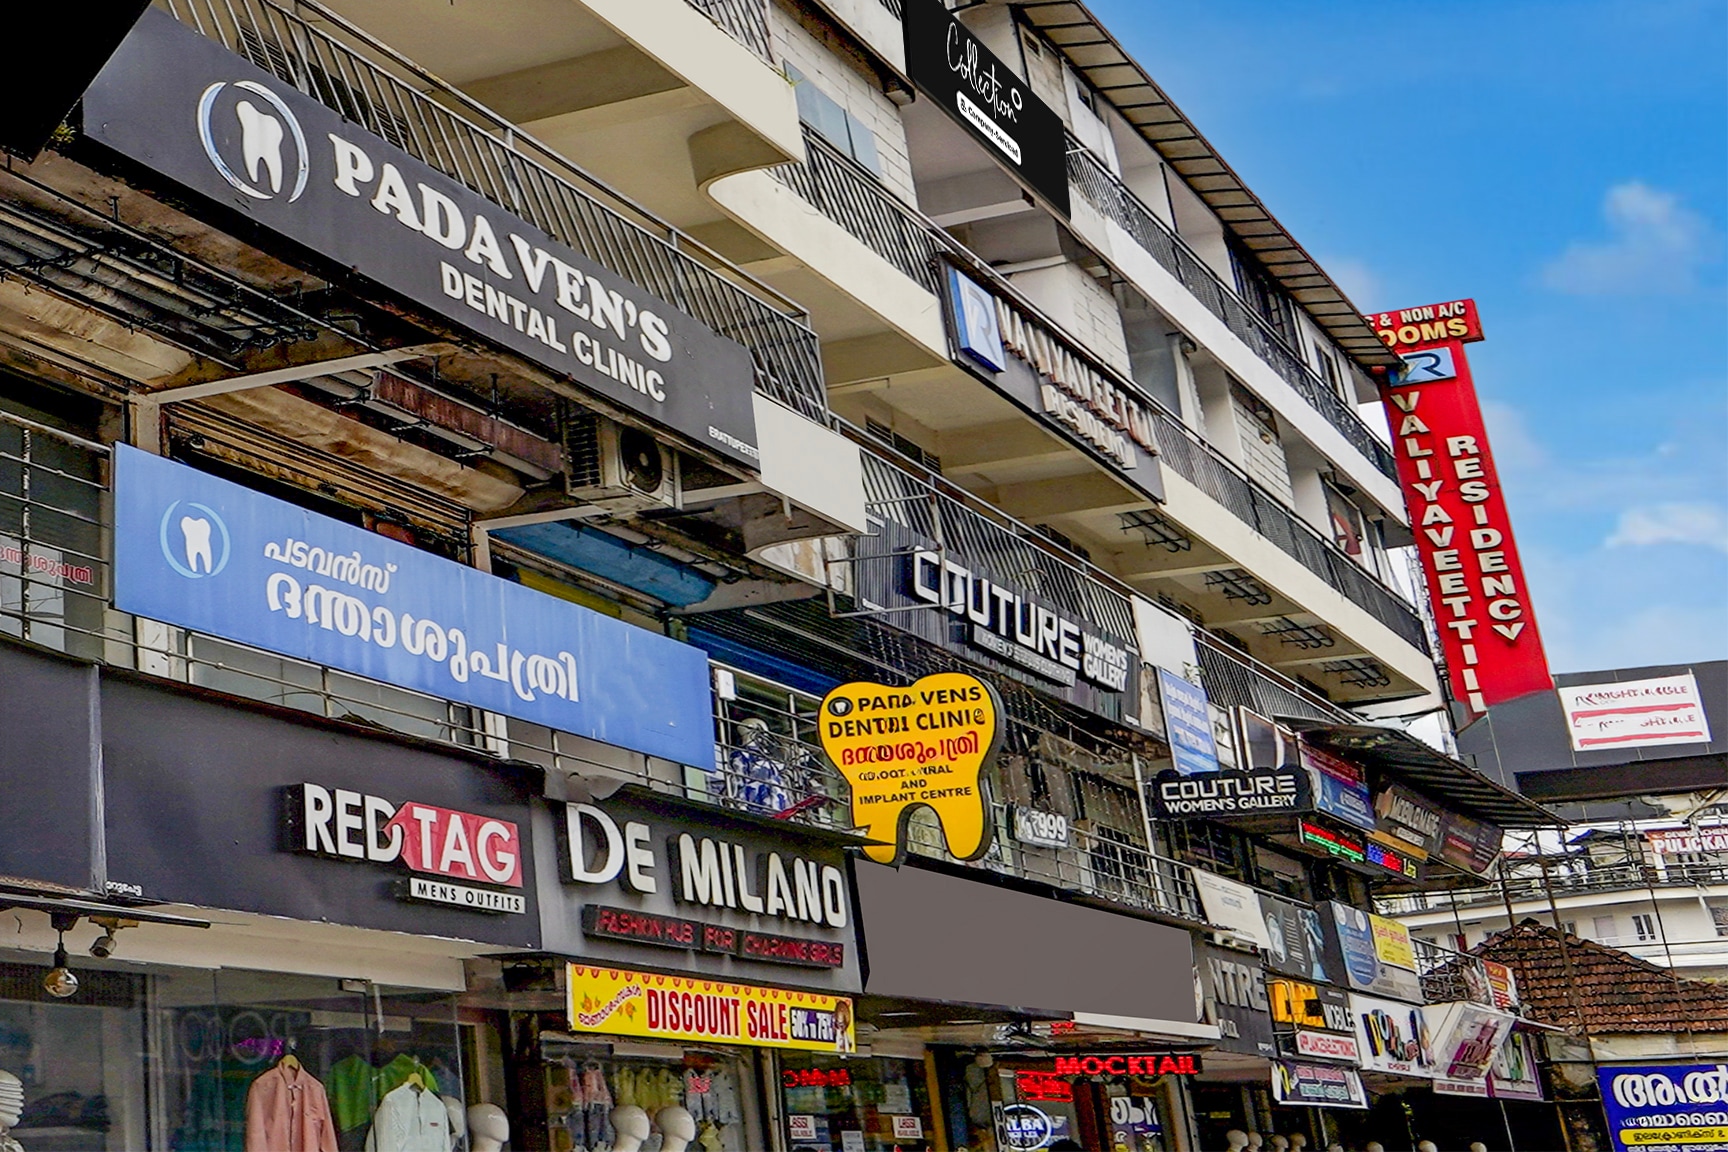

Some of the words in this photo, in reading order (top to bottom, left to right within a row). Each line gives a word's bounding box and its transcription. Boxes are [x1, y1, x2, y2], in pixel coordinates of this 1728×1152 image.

[1400, 307, 1435, 323] NON
[1438, 301, 1466, 318] A/C
[440, 261, 567, 355] DENTAL
[573, 329, 667, 404] CLINIC
[1377, 317, 1469, 347] OOMS
[913, 545, 1081, 671] COUTURE
[1082, 653, 1129, 693] GALLERY
[859, 791, 917, 805] IMPLANT
[920, 786, 973, 799] CENTRE
[900, 779, 928, 790] AND
[1160, 774, 1297, 800] COUTURE
[1164, 797, 1237, 814] WOMEN'S
[1237, 794, 1298, 809] GALLERY
[564, 801, 658, 896] DE
[675, 831, 848, 929] MILANO
[416, 882, 459, 901] MENS
[465, 889, 524, 913] OUTFITS
[646, 988, 742, 1038] DISCOUNT
[747, 999, 789, 1042] SALE
[1054, 1056, 1199, 1076] MOCKTAIL
